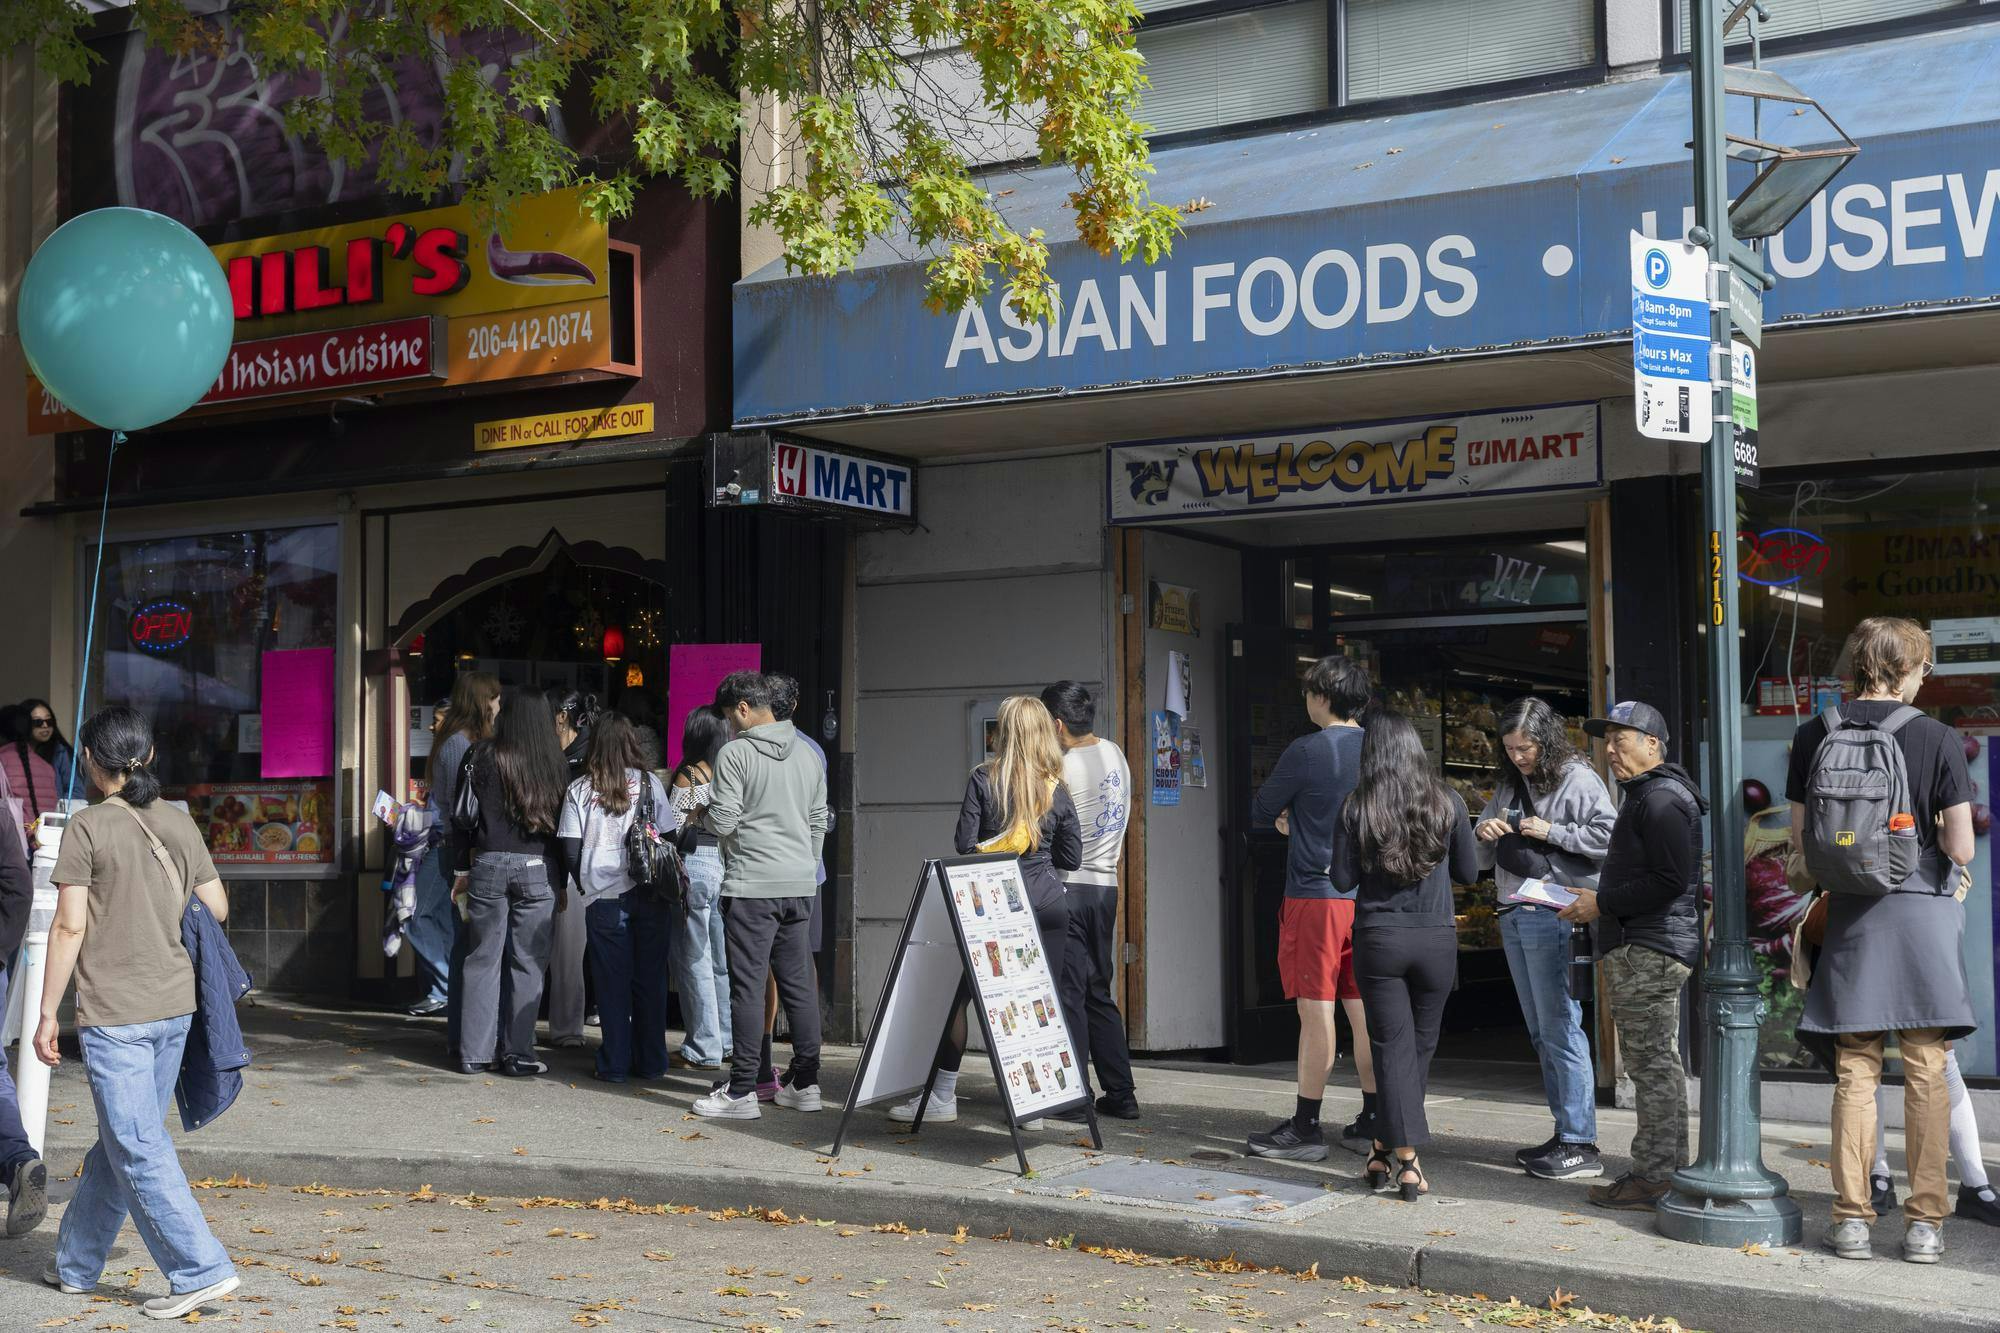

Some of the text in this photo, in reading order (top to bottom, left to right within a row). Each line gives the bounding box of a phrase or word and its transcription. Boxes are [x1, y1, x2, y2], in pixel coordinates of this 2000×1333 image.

[1651, 257, 1665, 280] P
[944, 269, 1167, 369] ASIAN
[1192, 234, 1478, 342] FOODS
[1645, 300, 1692, 319] 8am-8pm
[468, 310, 593, 360] 206-412-0874
[1655, 319, 1678, 328] Sun-Hol
[231, 348, 316, 393] Indian
[321, 331, 424, 377] Cuisine
[1649, 364, 1661, 372] limit
[1662, 365, 1676, 374] after
[1676, 366, 1690, 376] 5pm
[1670, 348, 1692, 363] Max
[481, 409, 644, 445] DINE IN or CALL FOR TAKE OUT
[1666, 418, 1678, 426] Enter
[1488, 432, 1585, 465] MART
[1734, 440, 1758, 466] 6682
[1193, 426, 1458, 504] WELCOME
[814, 454, 907, 511] MART
[1710, 530, 1724, 627] 4210
[131, 608, 193, 641] OPEN
[1155, 767, 1178, 778] CHOW
[236, 852, 265, 861] AVAILABLE
